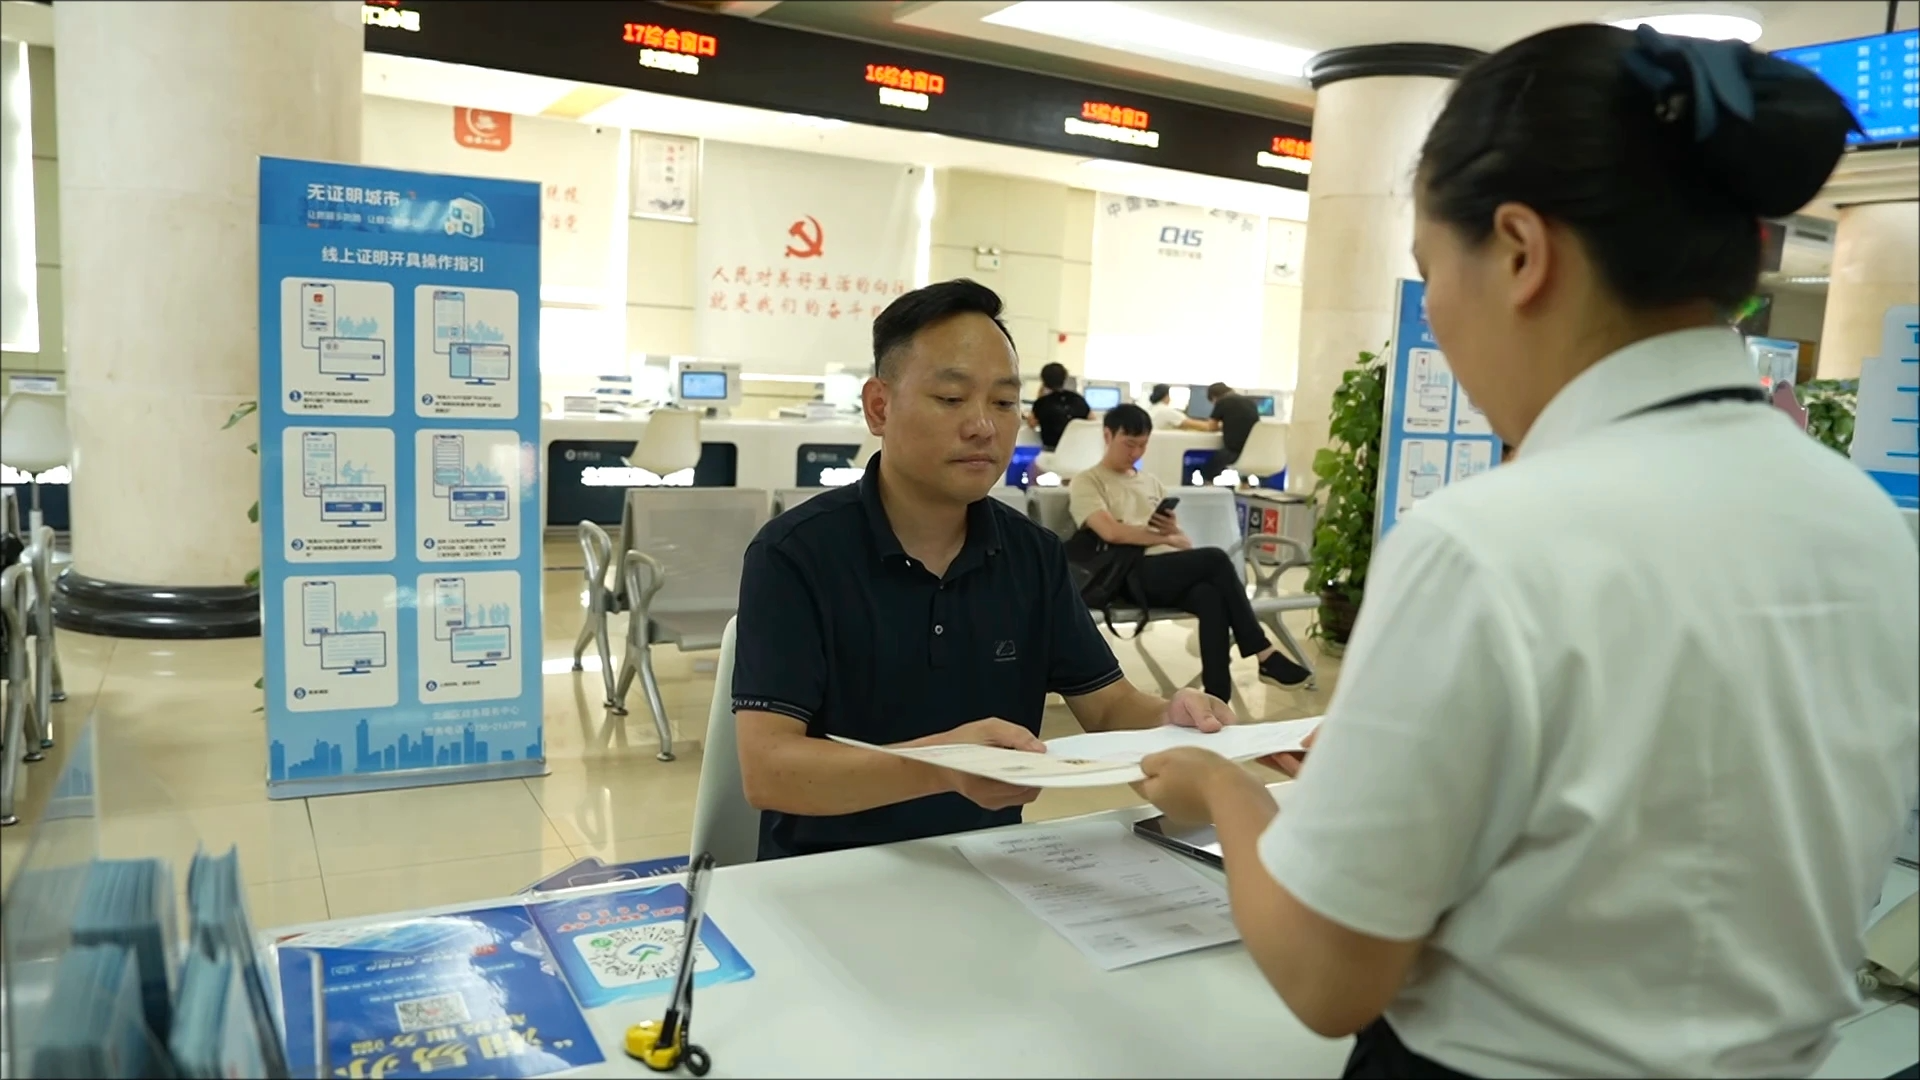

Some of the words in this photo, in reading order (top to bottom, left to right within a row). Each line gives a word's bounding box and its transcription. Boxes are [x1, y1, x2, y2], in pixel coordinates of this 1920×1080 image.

[622, 22, 717, 57] 17综合窗口
[865, 63, 945, 95] 16综合窗口
[1081, 100, 1150, 130] 15综合窗口
[307, 183, 401, 207] 无证明城市
[1159, 225, 1204, 247] CHS
[321, 245, 485, 273] 线上证明开具操作指引
[712, 265, 906, 297] 人民对美好生活的向往
